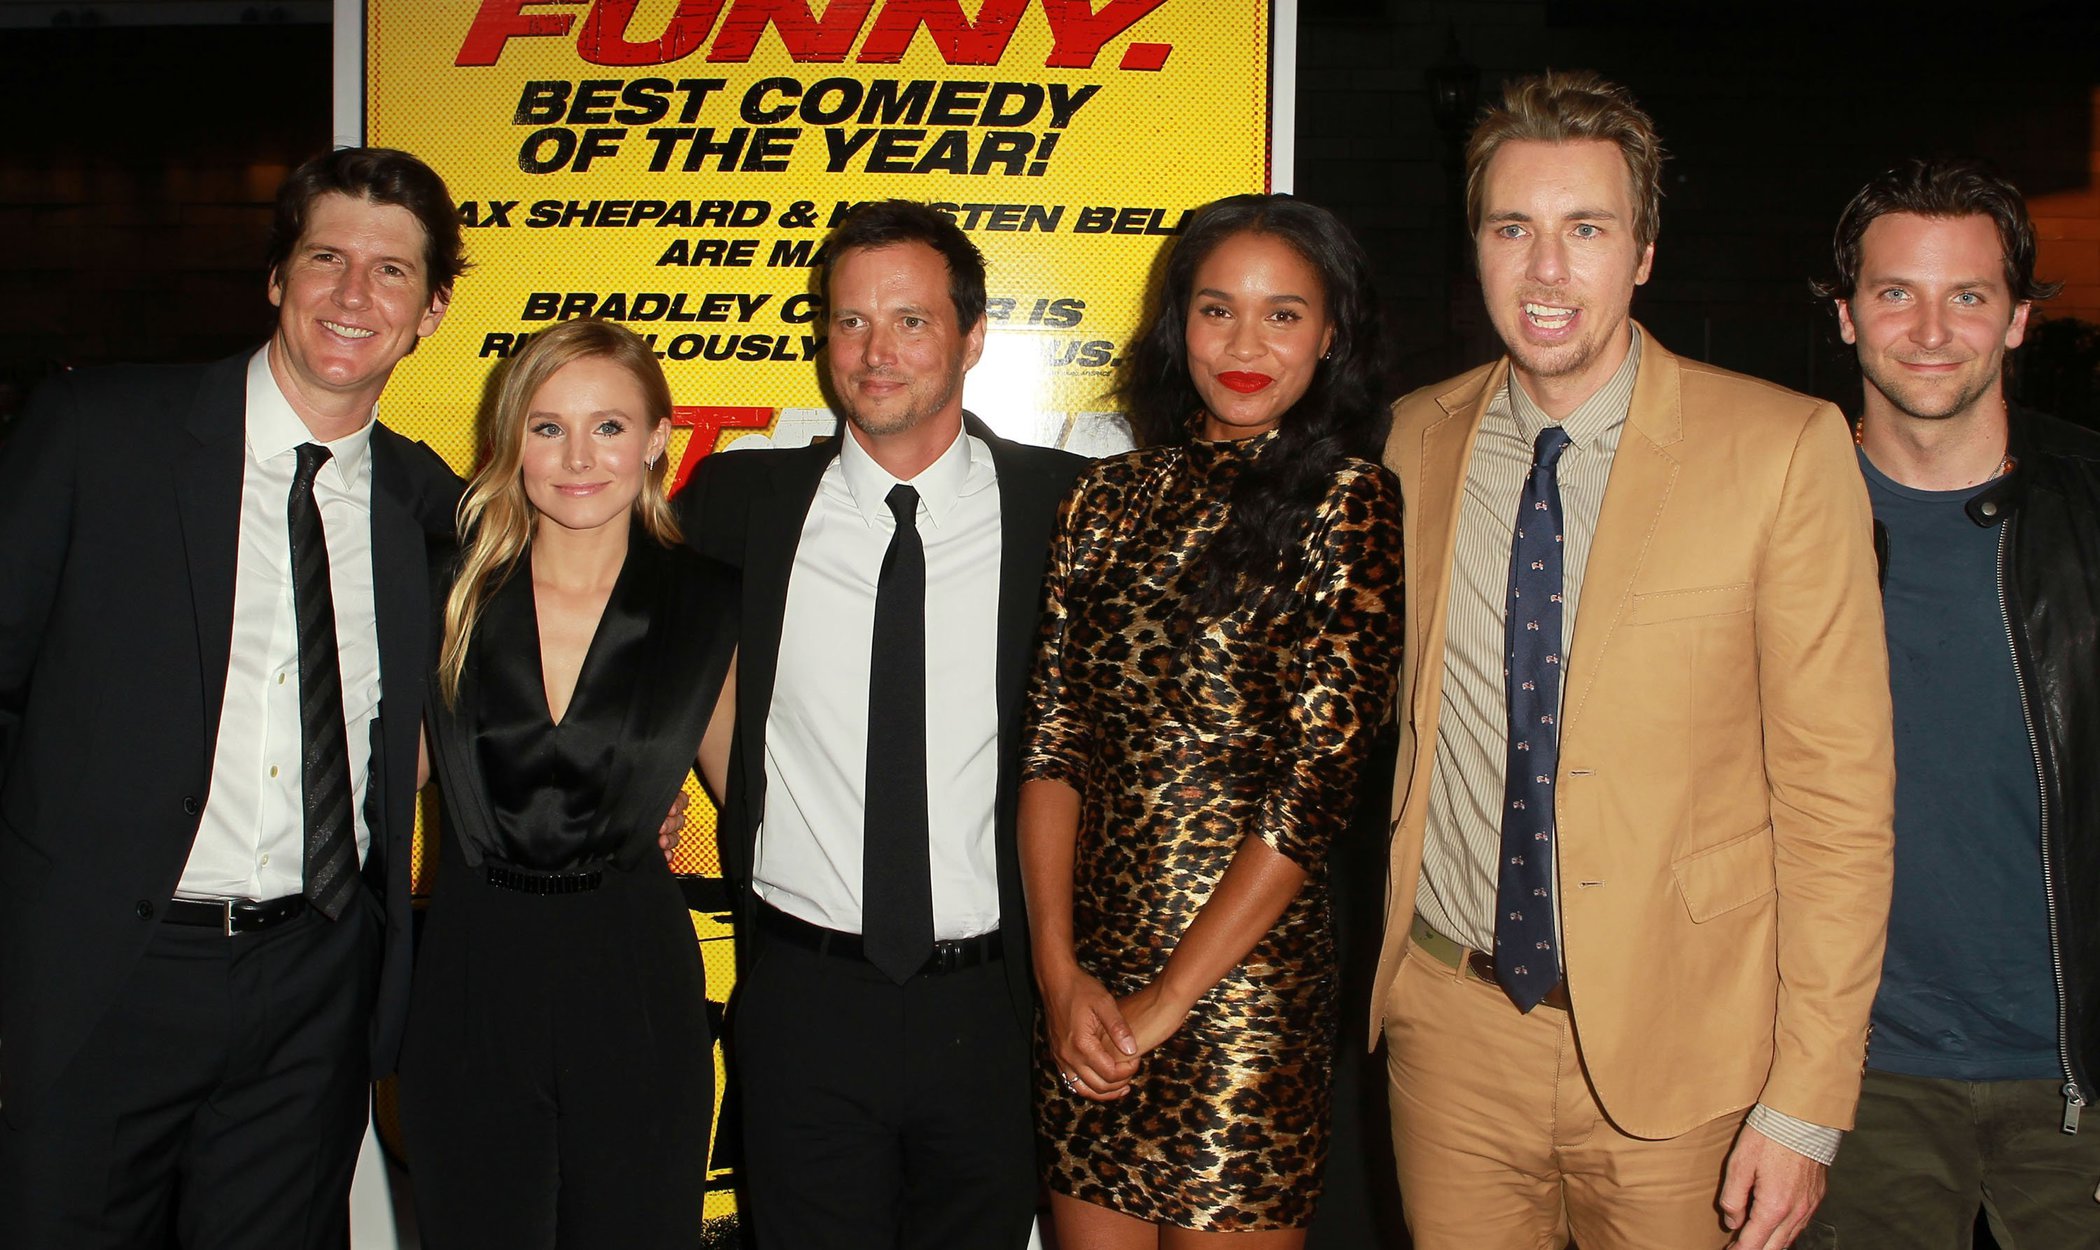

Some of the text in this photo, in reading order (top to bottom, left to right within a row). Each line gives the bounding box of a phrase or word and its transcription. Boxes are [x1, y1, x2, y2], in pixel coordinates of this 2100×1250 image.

[454, 0, 1174, 72] FUNNY.
[512, 77, 1103, 129] BEST COMEDY
[518, 127, 1060, 177] OF THE YEAR!
[456, 201, 520, 228] AX
[525, 200, 772, 229] SHEPARD
[778, 200, 819, 229] &
[656, 240, 755, 267] ARE
[521, 292, 773, 323] BRADLEY
[1028, 298, 1087, 329] IS
